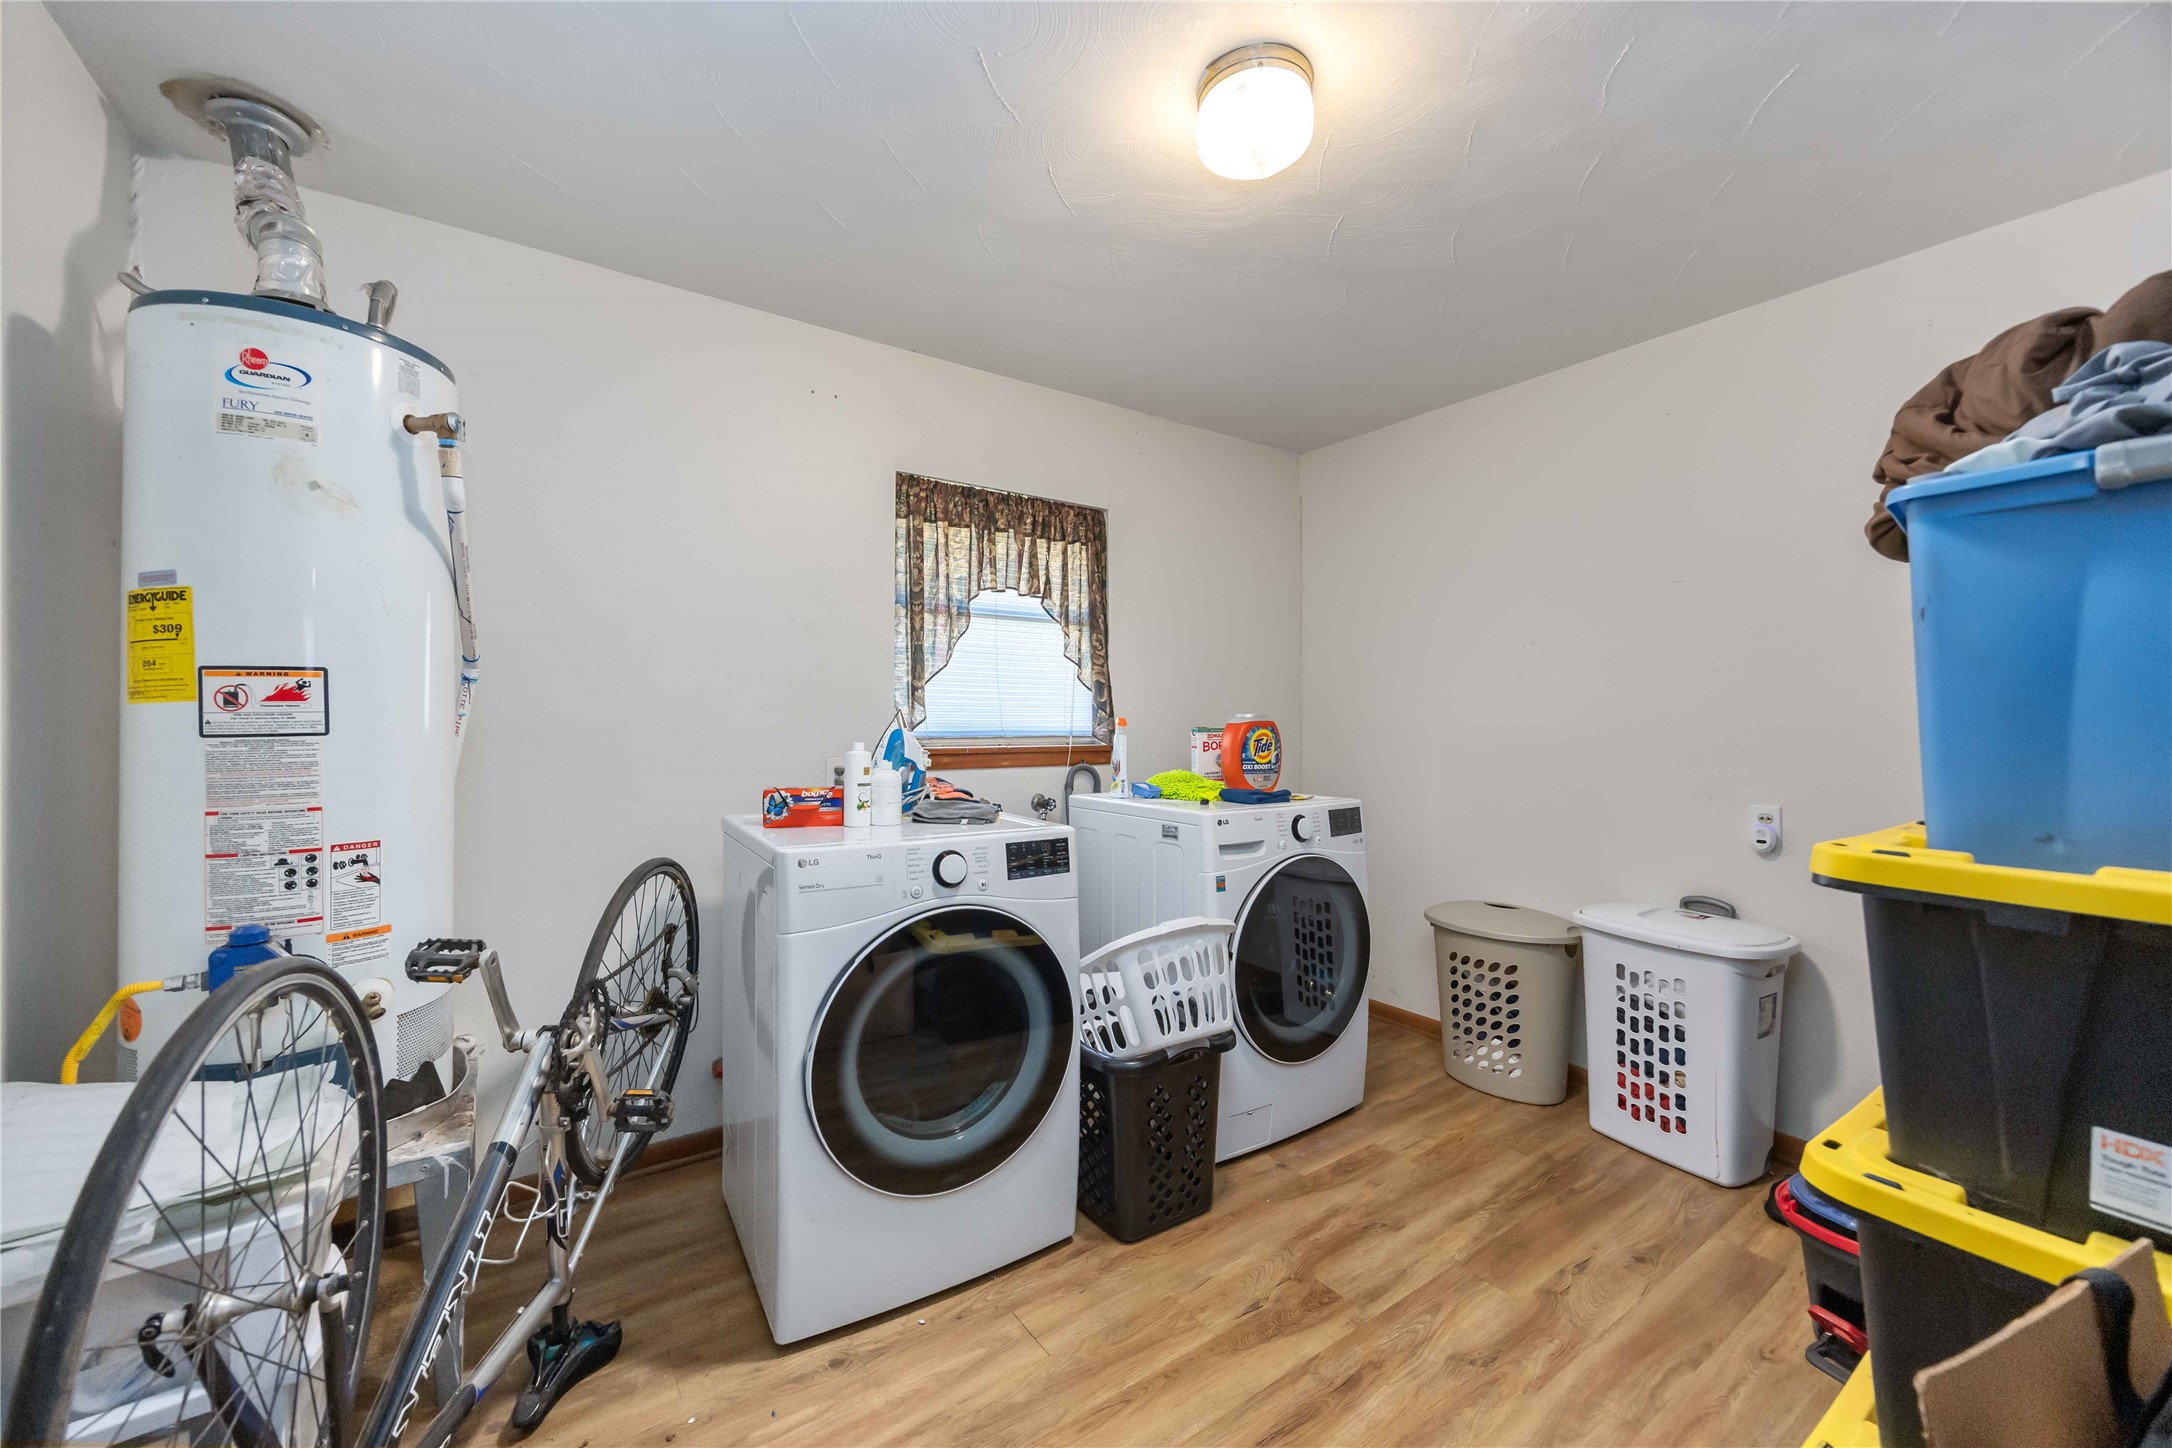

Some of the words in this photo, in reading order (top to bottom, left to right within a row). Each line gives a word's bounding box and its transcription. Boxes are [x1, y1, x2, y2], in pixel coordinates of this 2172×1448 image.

[241, 348, 268, 368] Rheem
[239, 369, 291, 382] GUARDIAN
[222, 397, 259, 410] FURY
[152, 623, 182, 634] $309
[1253, 738, 1273, 757] Tide
[801, 789, 833, 798] bounce
[343, 841, 378, 851] DANGER
[808, 858, 820, 866] LG
[352, 928, 379, 938] WARNING
[2100, 1134, 2165, 1168] HDX
